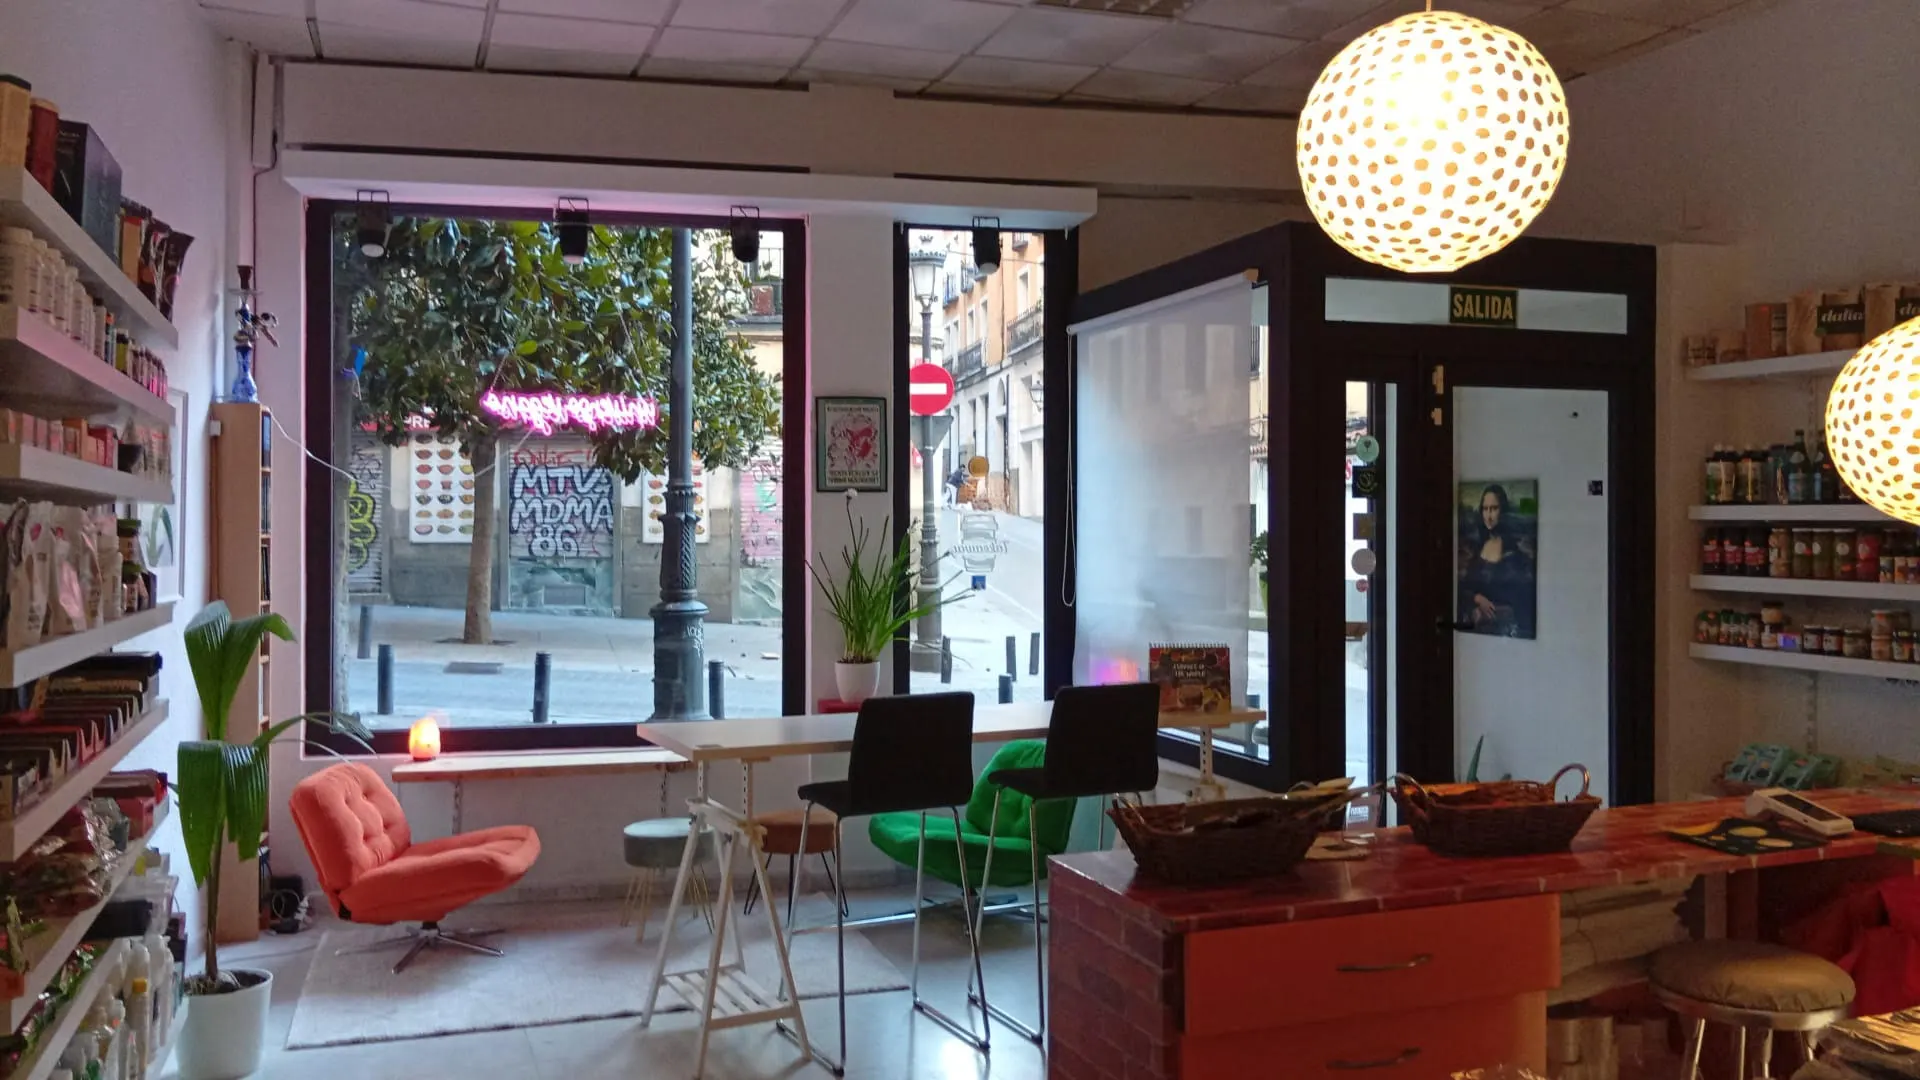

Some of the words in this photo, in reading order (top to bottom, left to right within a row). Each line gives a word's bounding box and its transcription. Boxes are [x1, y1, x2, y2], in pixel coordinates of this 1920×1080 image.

[1452, 293, 1514, 321] SALIDA
[510, 496, 615, 534] MDMA
[530, 524, 580, 557] 86
